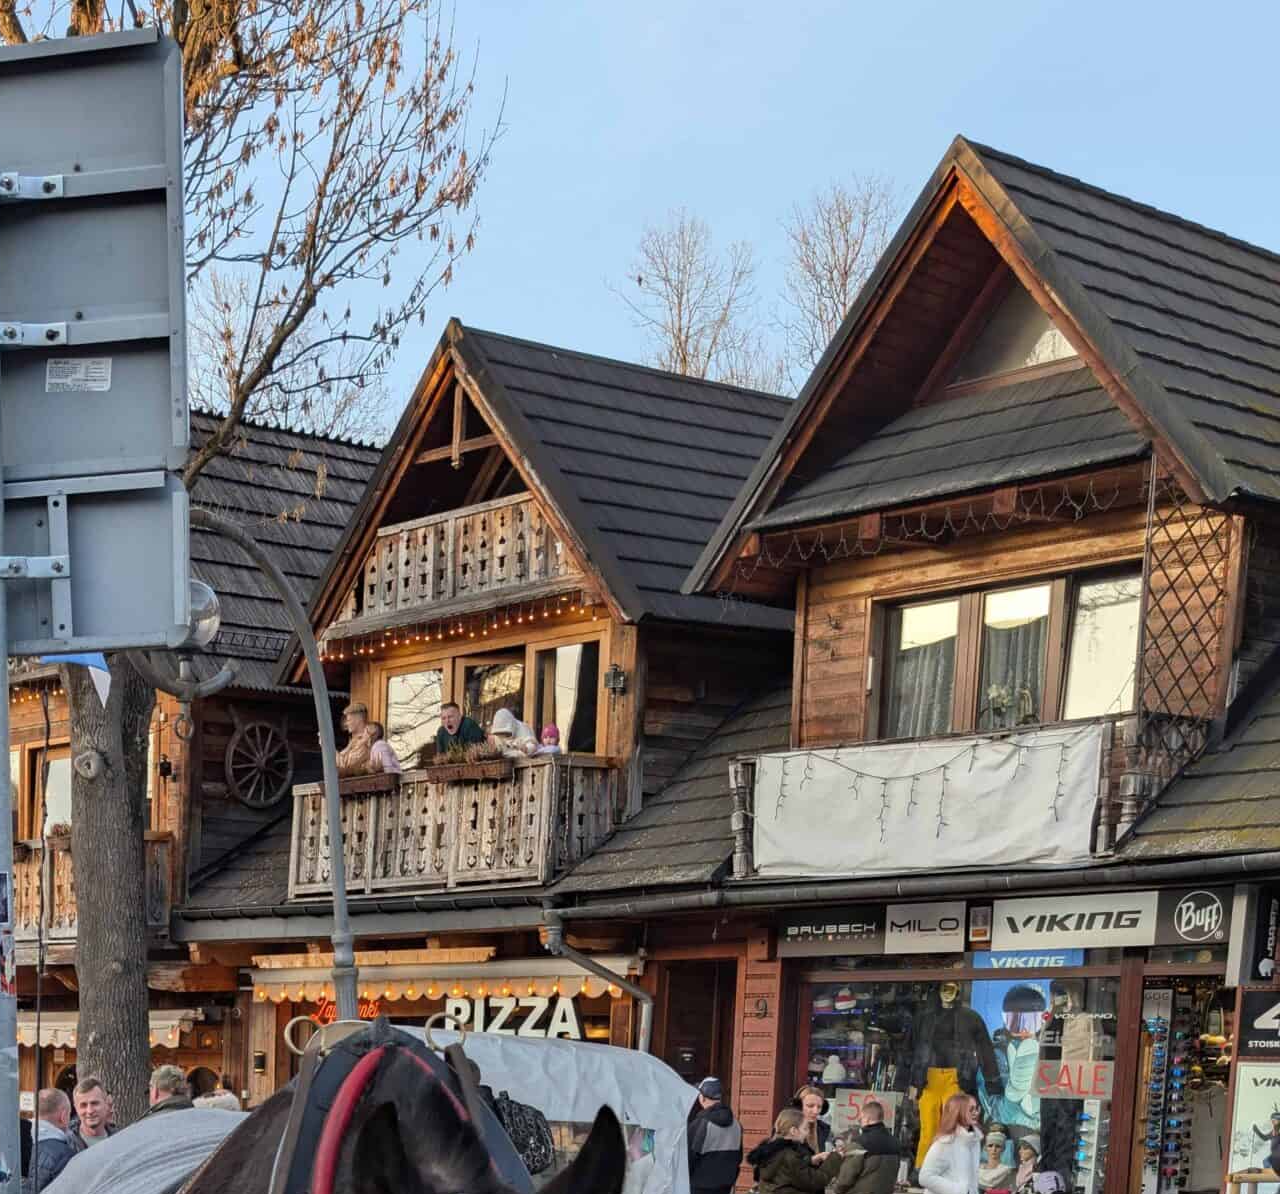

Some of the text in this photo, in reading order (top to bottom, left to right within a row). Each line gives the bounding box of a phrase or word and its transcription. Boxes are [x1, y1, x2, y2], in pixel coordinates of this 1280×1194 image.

[889, 917, 960, 933] MILO
[1005, 910, 1142, 934] VIKING
[990, 956, 1065, 969] VIKING
[444, 997, 582, 1040] PIZZA
[754, 998, 769, 1019] 9
[1038, 1063, 1107, 1096] SALE
